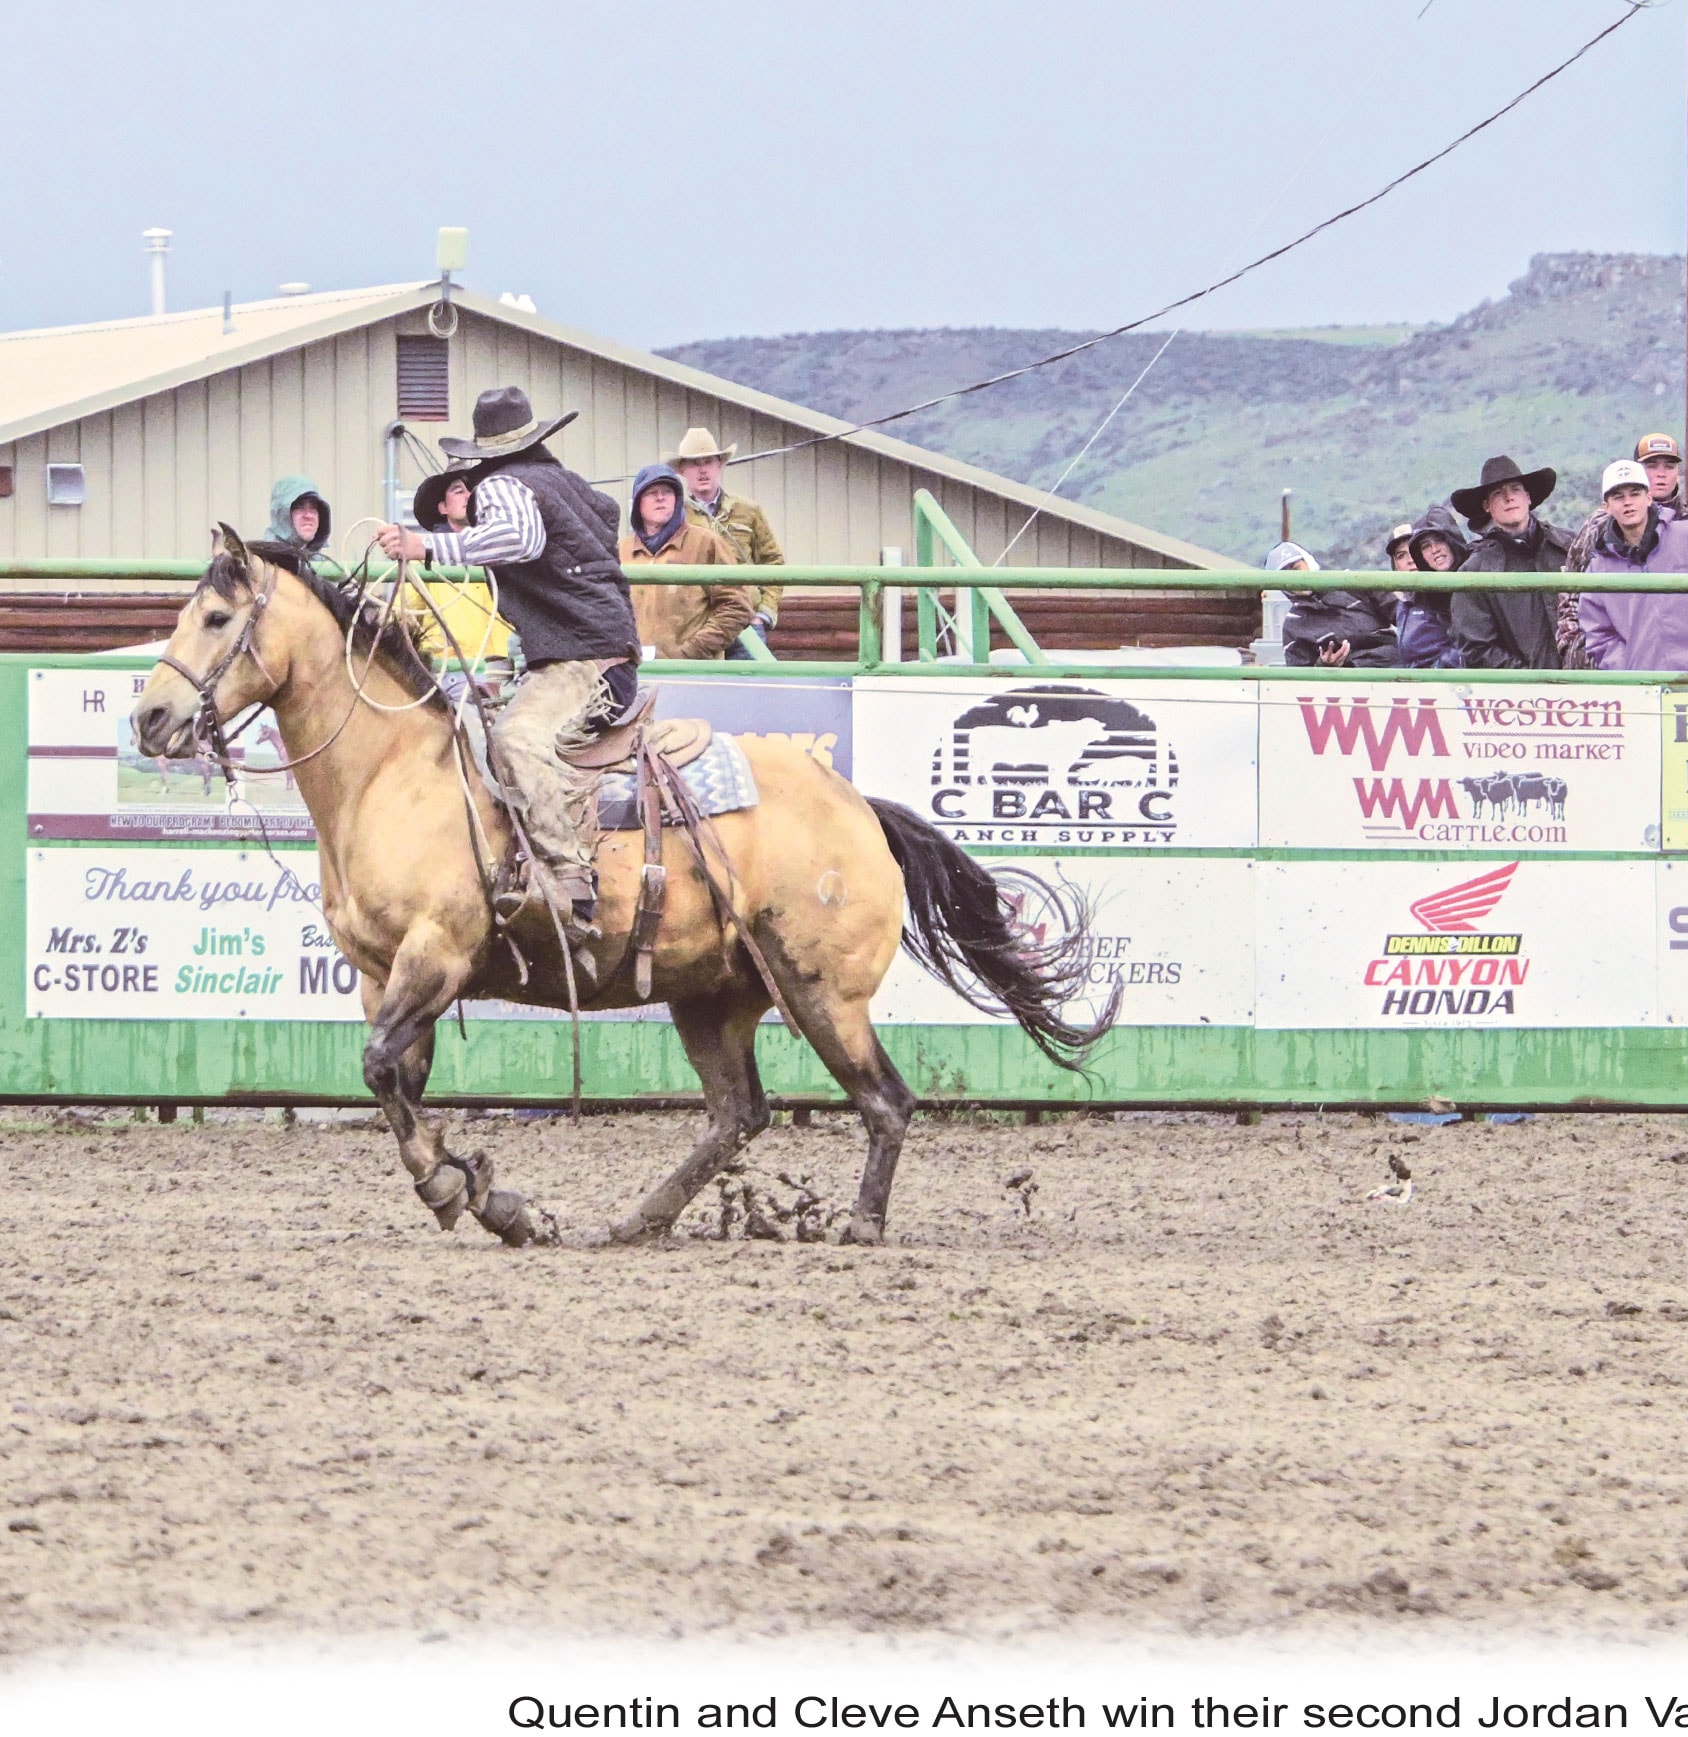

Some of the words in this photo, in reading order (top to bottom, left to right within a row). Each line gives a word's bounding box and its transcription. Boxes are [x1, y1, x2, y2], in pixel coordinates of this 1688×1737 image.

[931, 789, 967, 818] C
[993, 789, 1114, 819] BAR
[1138, 790, 1174, 821] C
[952, 829, 1038, 841] ANCH
[1058, 830, 1175, 843] SUPPLY
[85, 867, 197, 901] Thank
[199, 881, 267, 911] you
[266, 868, 321, 912] fro
[46, 928, 101, 953] Mrs.
[109, 927, 148, 954] Z's
[193, 927, 265, 956] Jim's
[1387, 936, 1449, 954] DENNIS
[1456, 936, 1518, 953] DILLON
[34, 965, 158, 992] C-STORE
[175, 965, 283, 994] Sinclair
[1057, 962, 1182, 984] CKERS
[1363, 959, 1530, 986] CANYON
[1381, 989, 1515, 1015] HONDA
